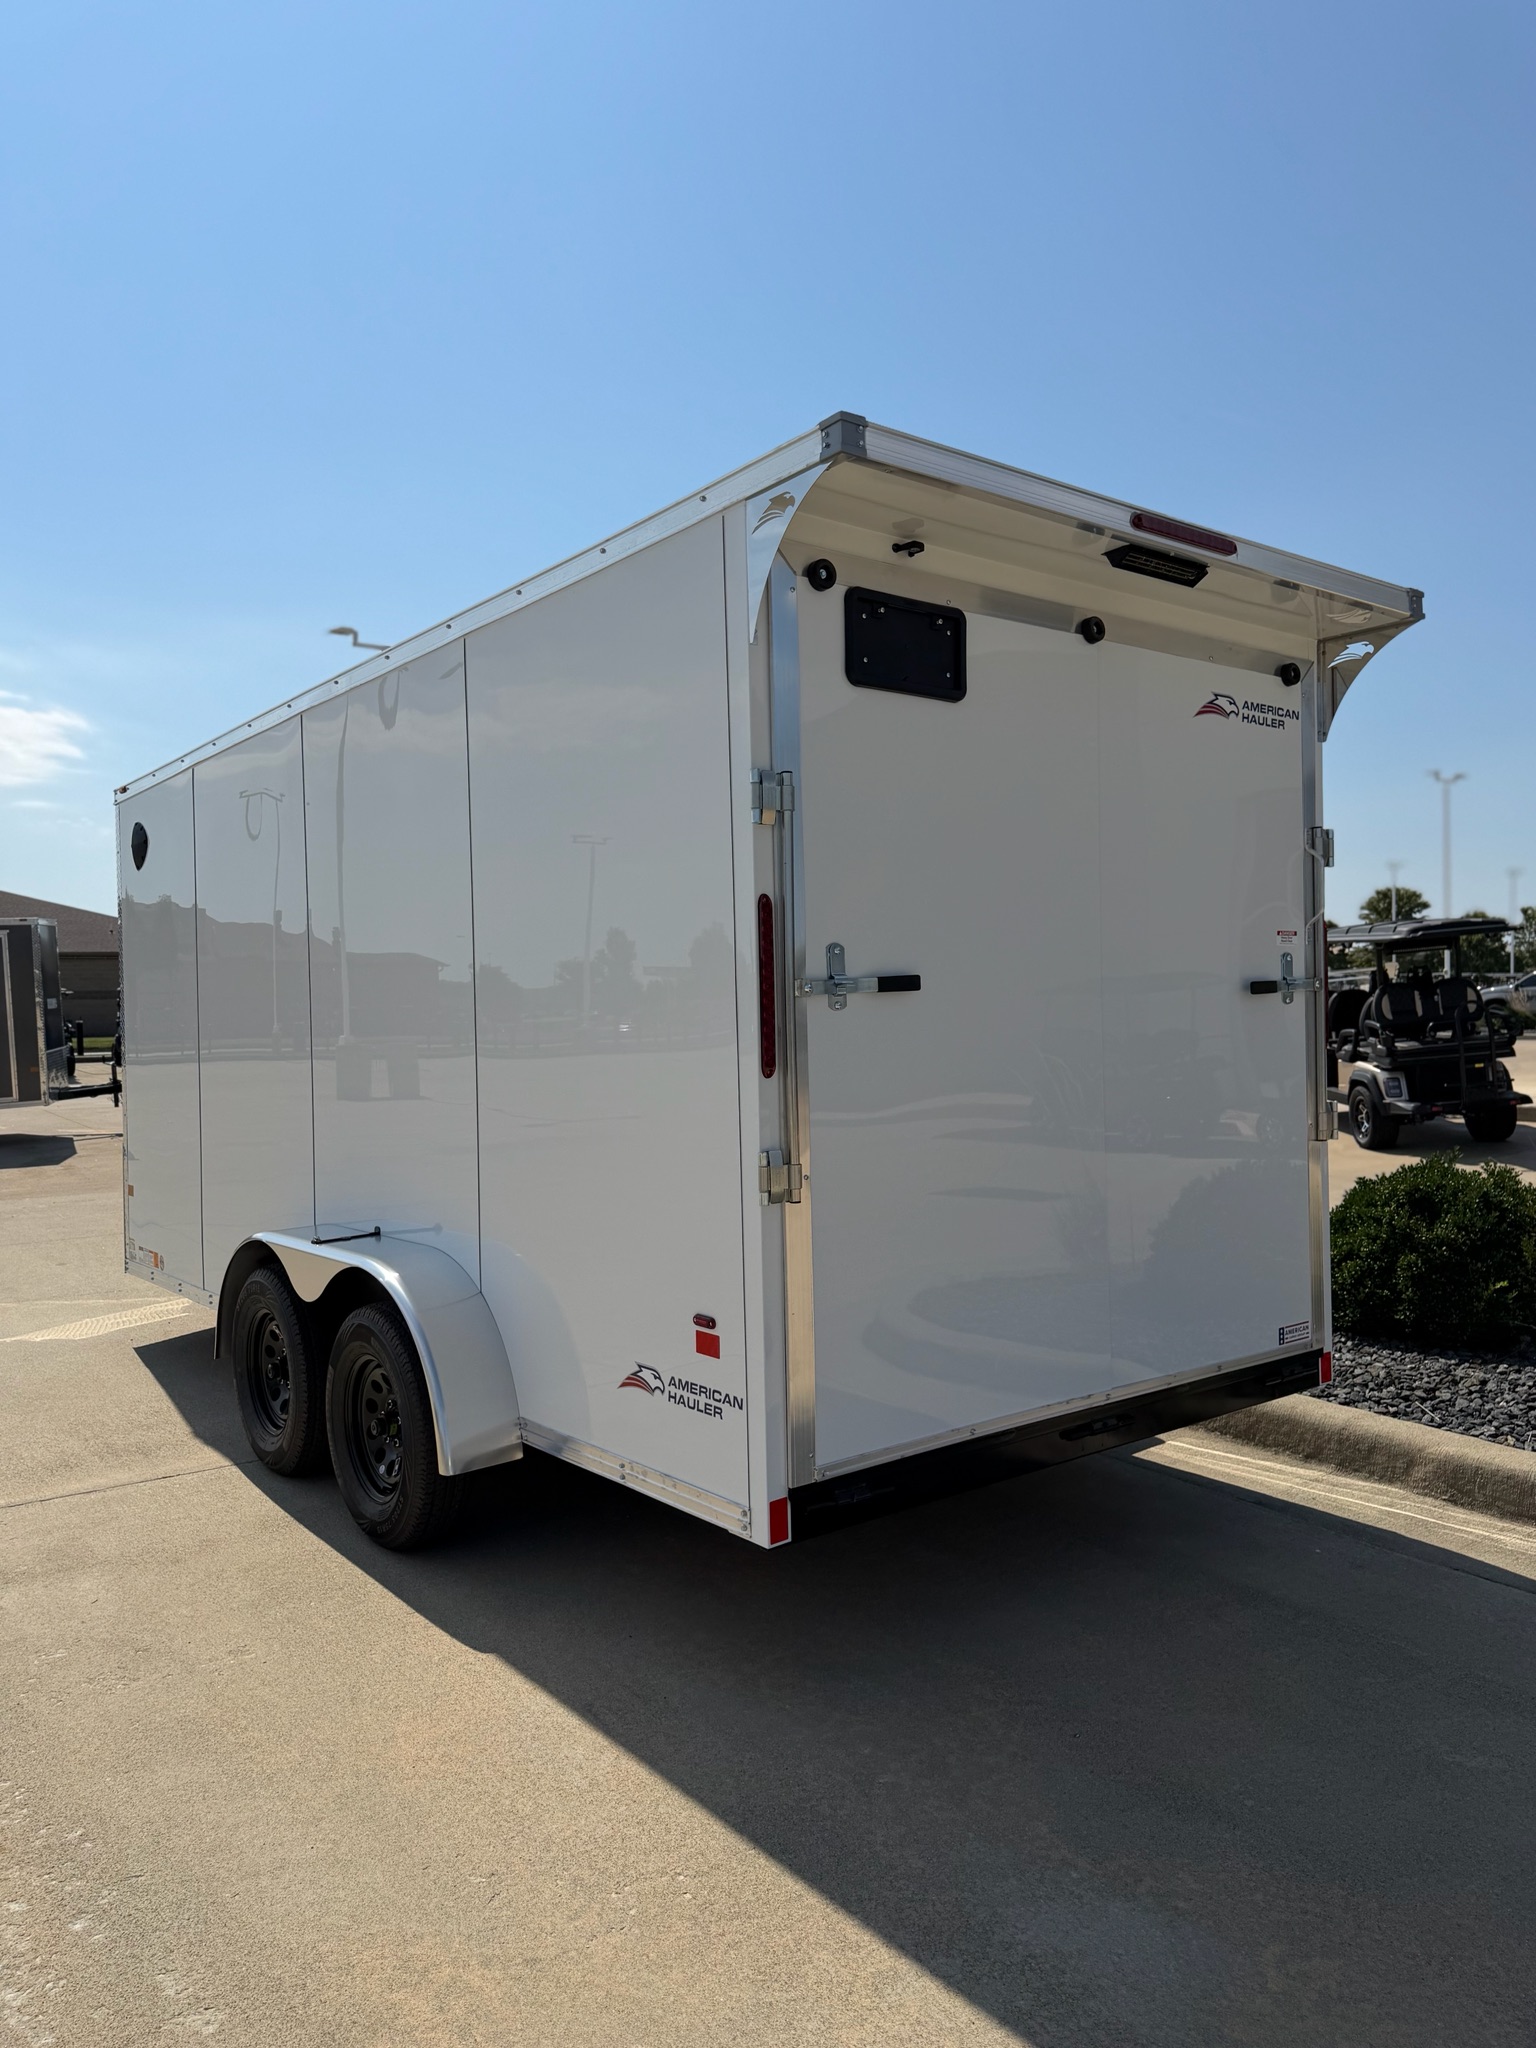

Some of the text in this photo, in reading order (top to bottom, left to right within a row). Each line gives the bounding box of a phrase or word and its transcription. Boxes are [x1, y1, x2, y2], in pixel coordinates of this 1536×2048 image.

[1242, 701, 1299, 720] AMERICAN
[1242, 713, 1285, 730] HAULER
[1284, 1325, 1309, 1335] AMERICAN
[667, 1375, 744, 1411] AMERICAN
[667, 1390, 723, 1420] HAULER
